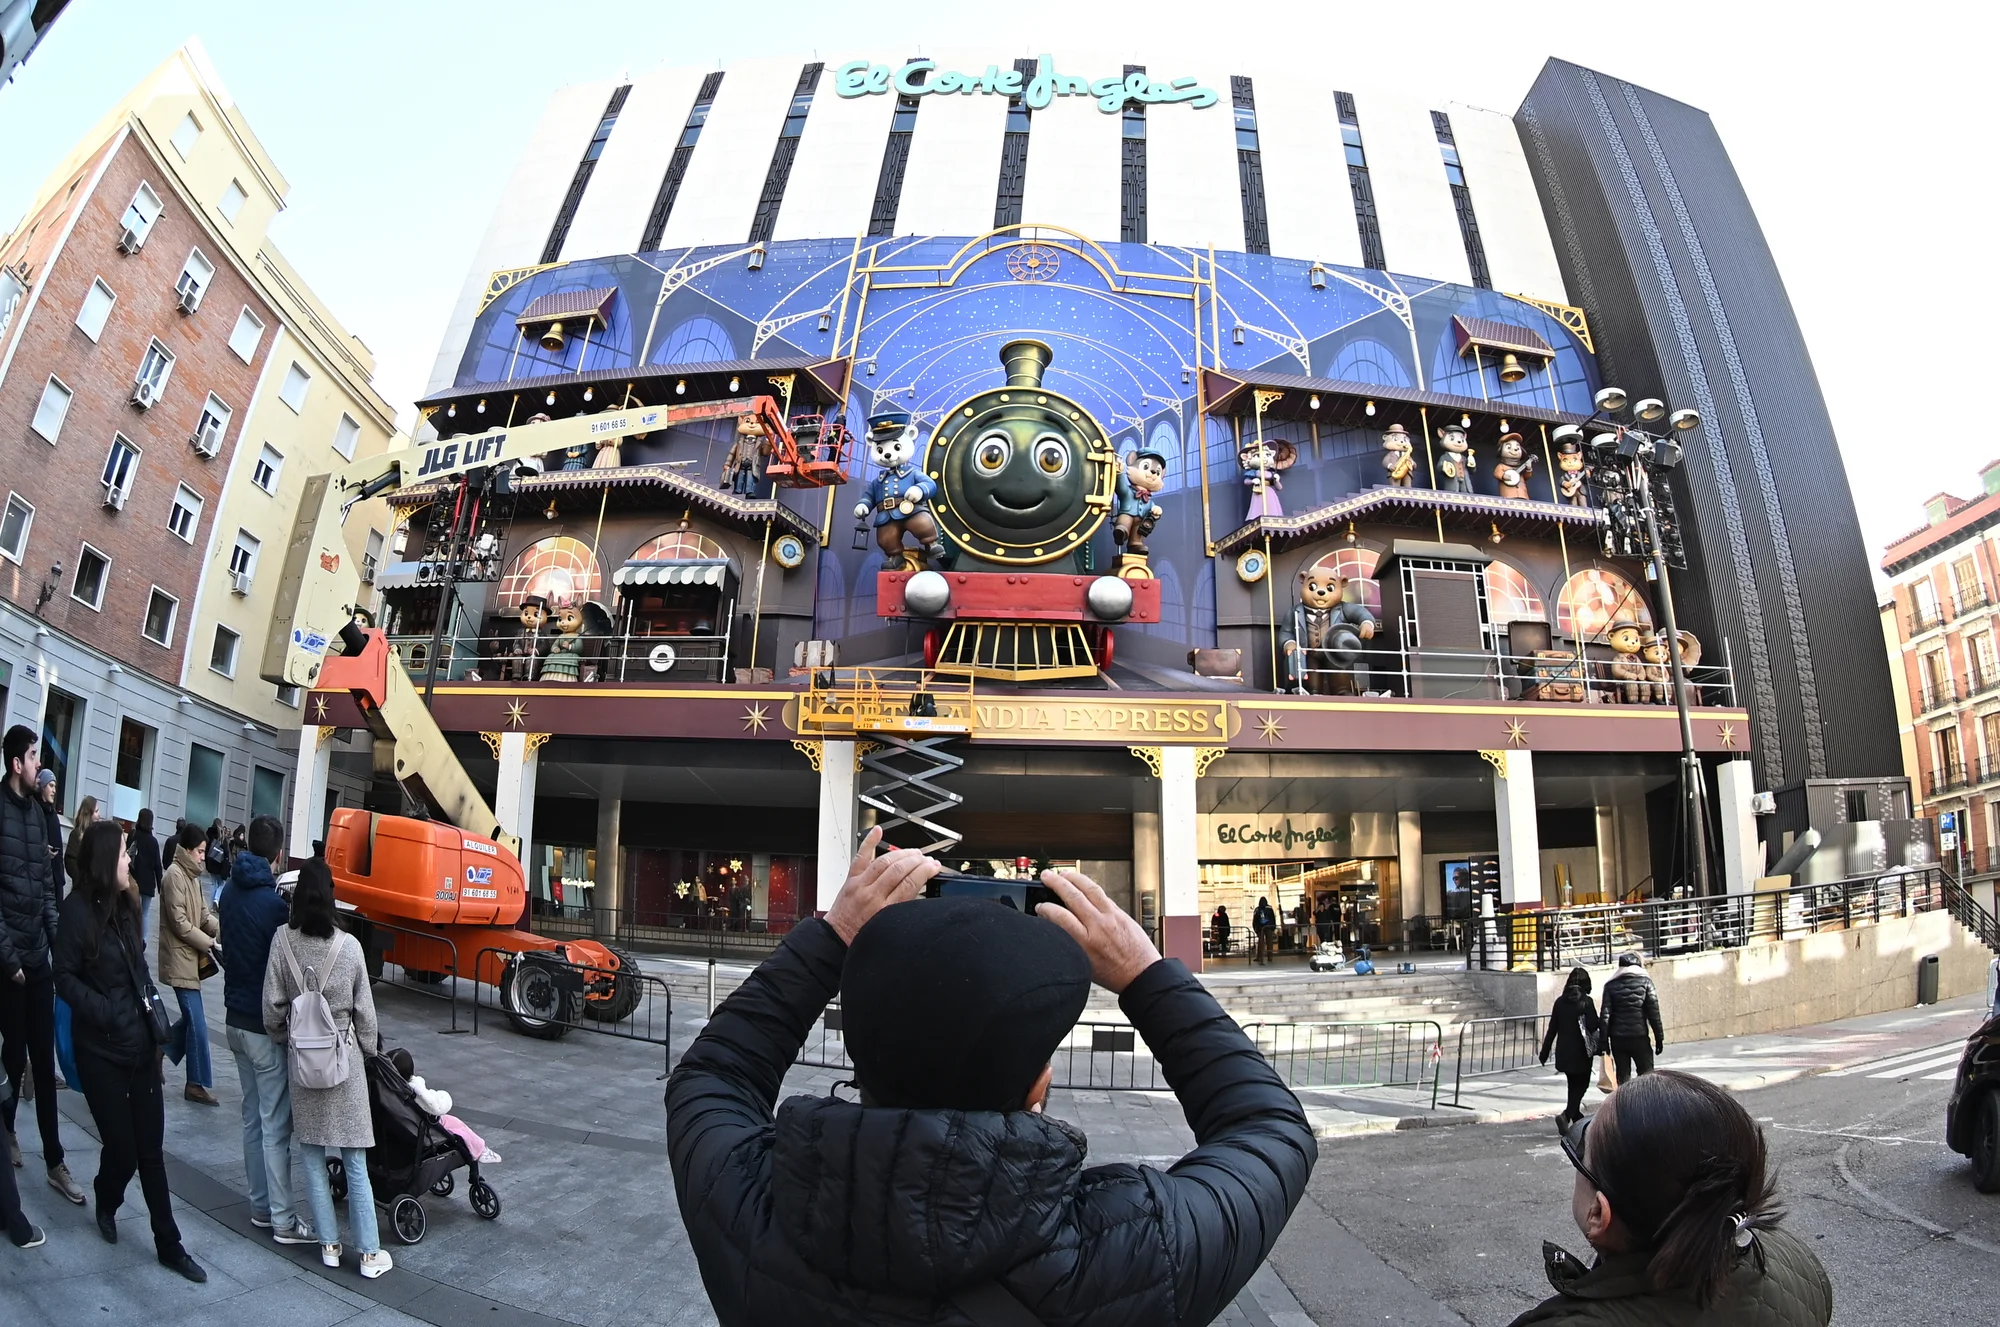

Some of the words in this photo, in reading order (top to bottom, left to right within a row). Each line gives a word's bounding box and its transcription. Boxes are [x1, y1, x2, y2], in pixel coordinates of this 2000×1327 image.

[835, 61, 890, 98] El
[894, 61, 1023, 98] Corte
[591, 424, 599, 433] 91
[600, 421, 610, 431] 601
[611, 419, 619, 429] 68
[619, 418, 627, 428] 55
[417, 443, 459, 477] JLG
[462, 434, 507, 466] LIFT
[1063, 707, 1209, 734] EXPRESS
[1217, 823, 1238, 844] El
[1238, 824, 1283, 844] Corte
[466, 841, 496, 854] ALQUILER
[463, 888, 470, 896] 91
[471, 889, 482, 897] 601
[298, 1224, 308, 1237] N
